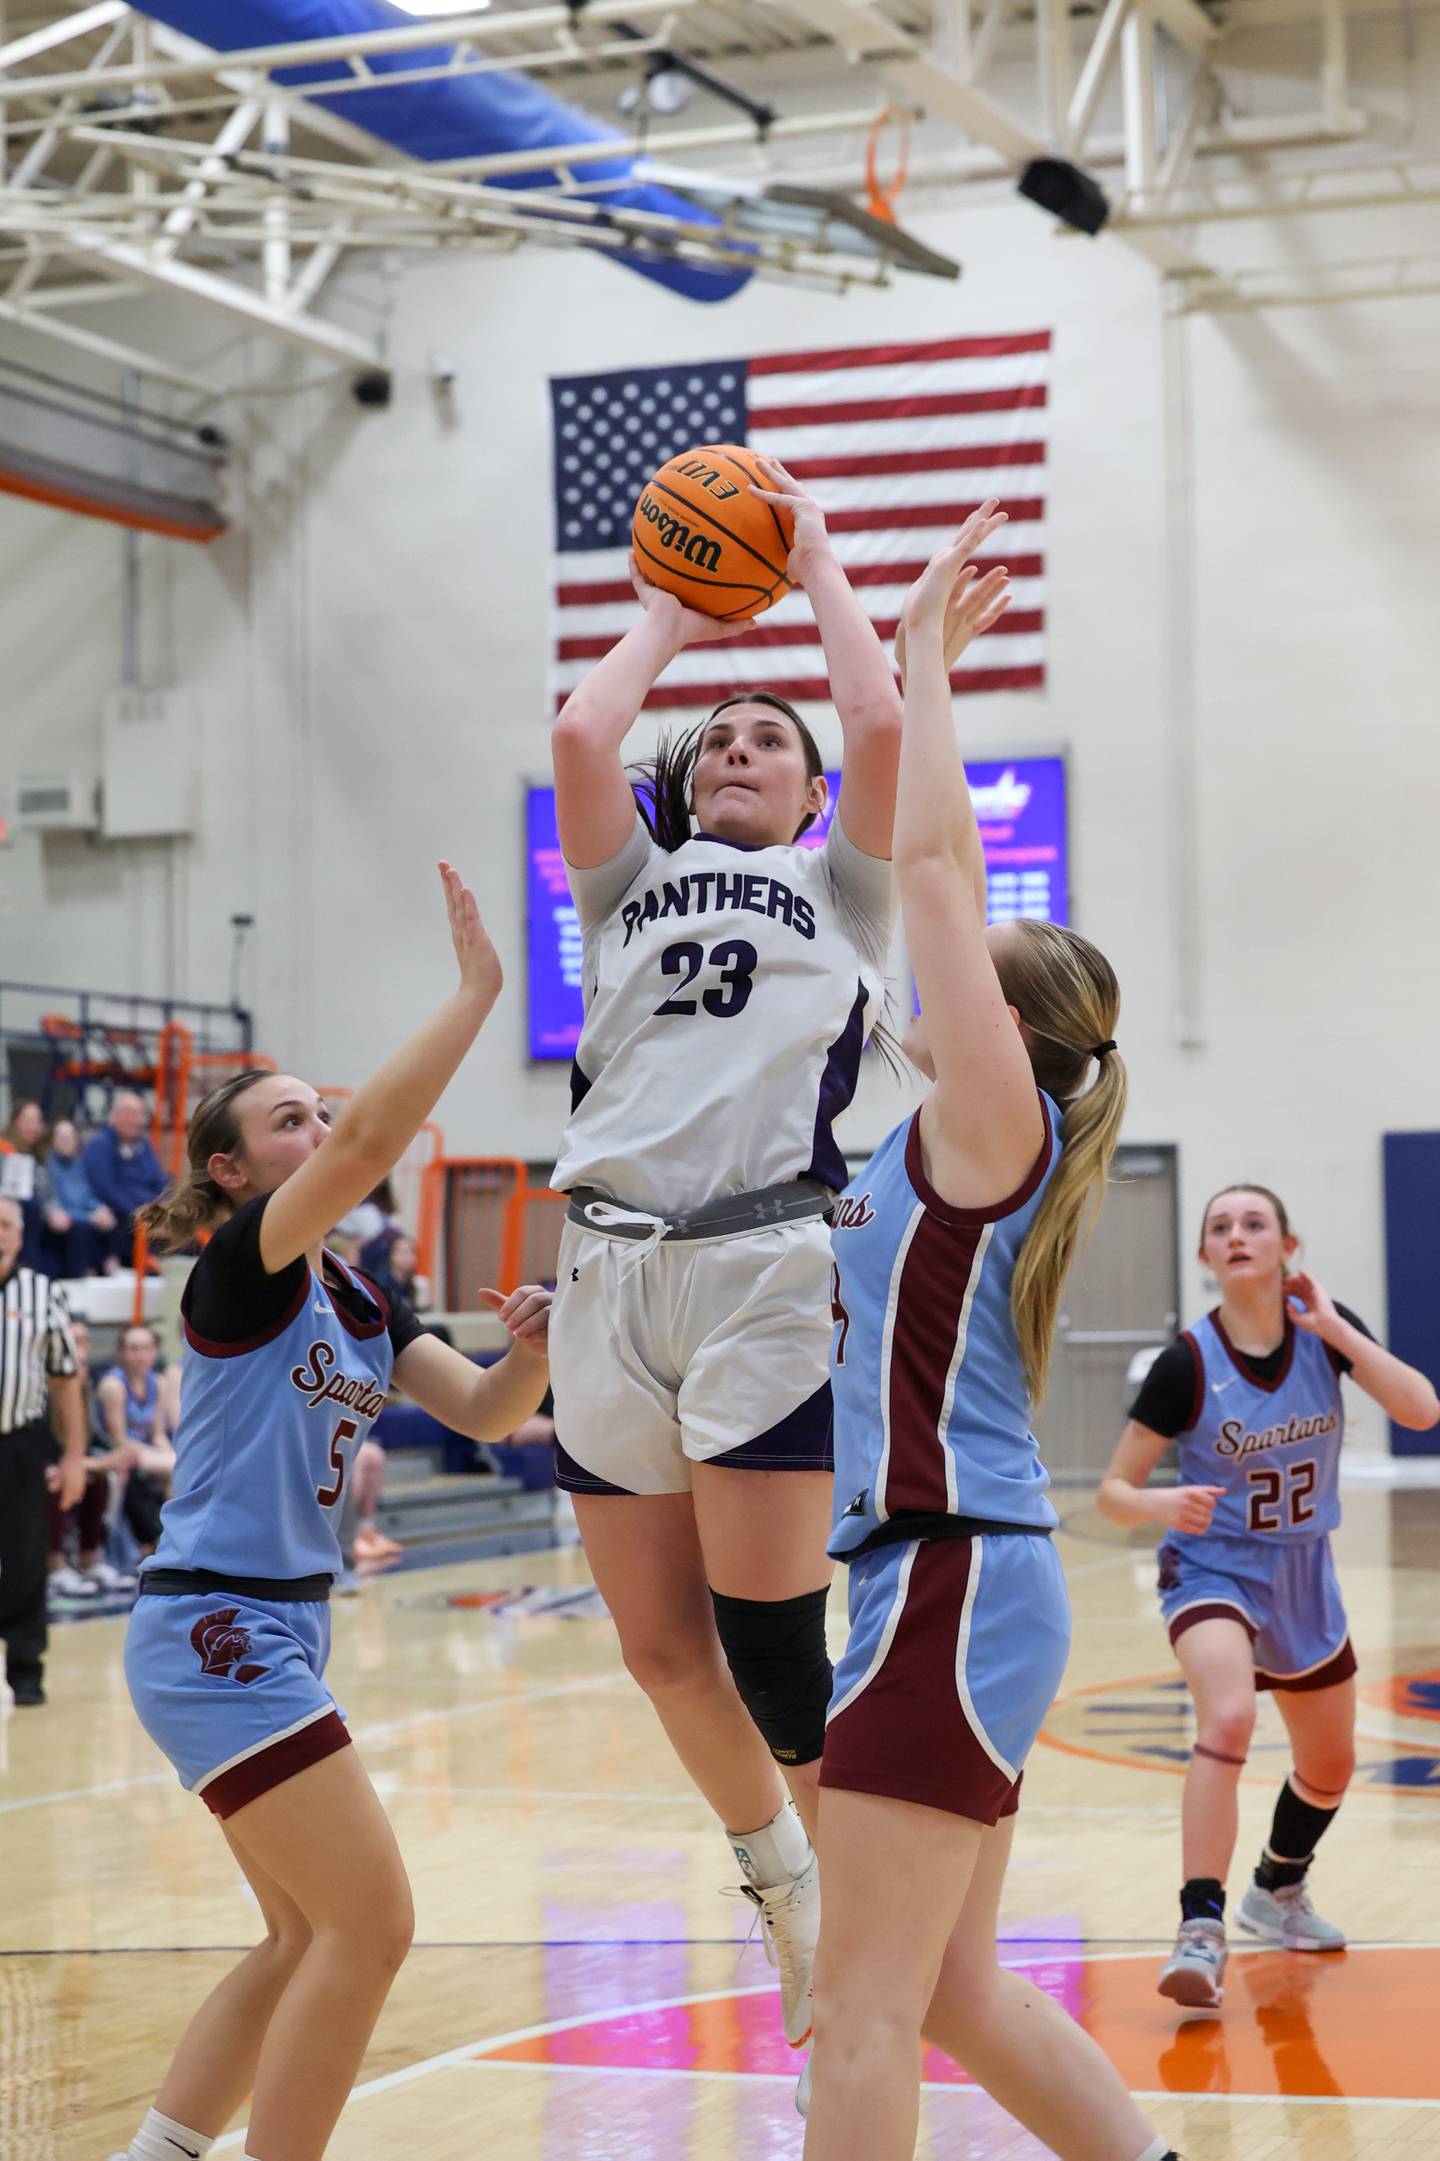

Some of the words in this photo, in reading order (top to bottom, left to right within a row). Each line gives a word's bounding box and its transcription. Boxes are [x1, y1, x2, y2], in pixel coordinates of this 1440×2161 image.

[639, 494, 723, 573] Wilson
[621, 872, 816, 949] PANTHERS
[653, 939, 758, 1018] 23
[290, 1340, 387, 1420] Sparta
[316, 1417, 359, 1509] 5
[1215, 1409, 1338, 1465] Spartans
[1248, 1458, 1317, 1531] 22
